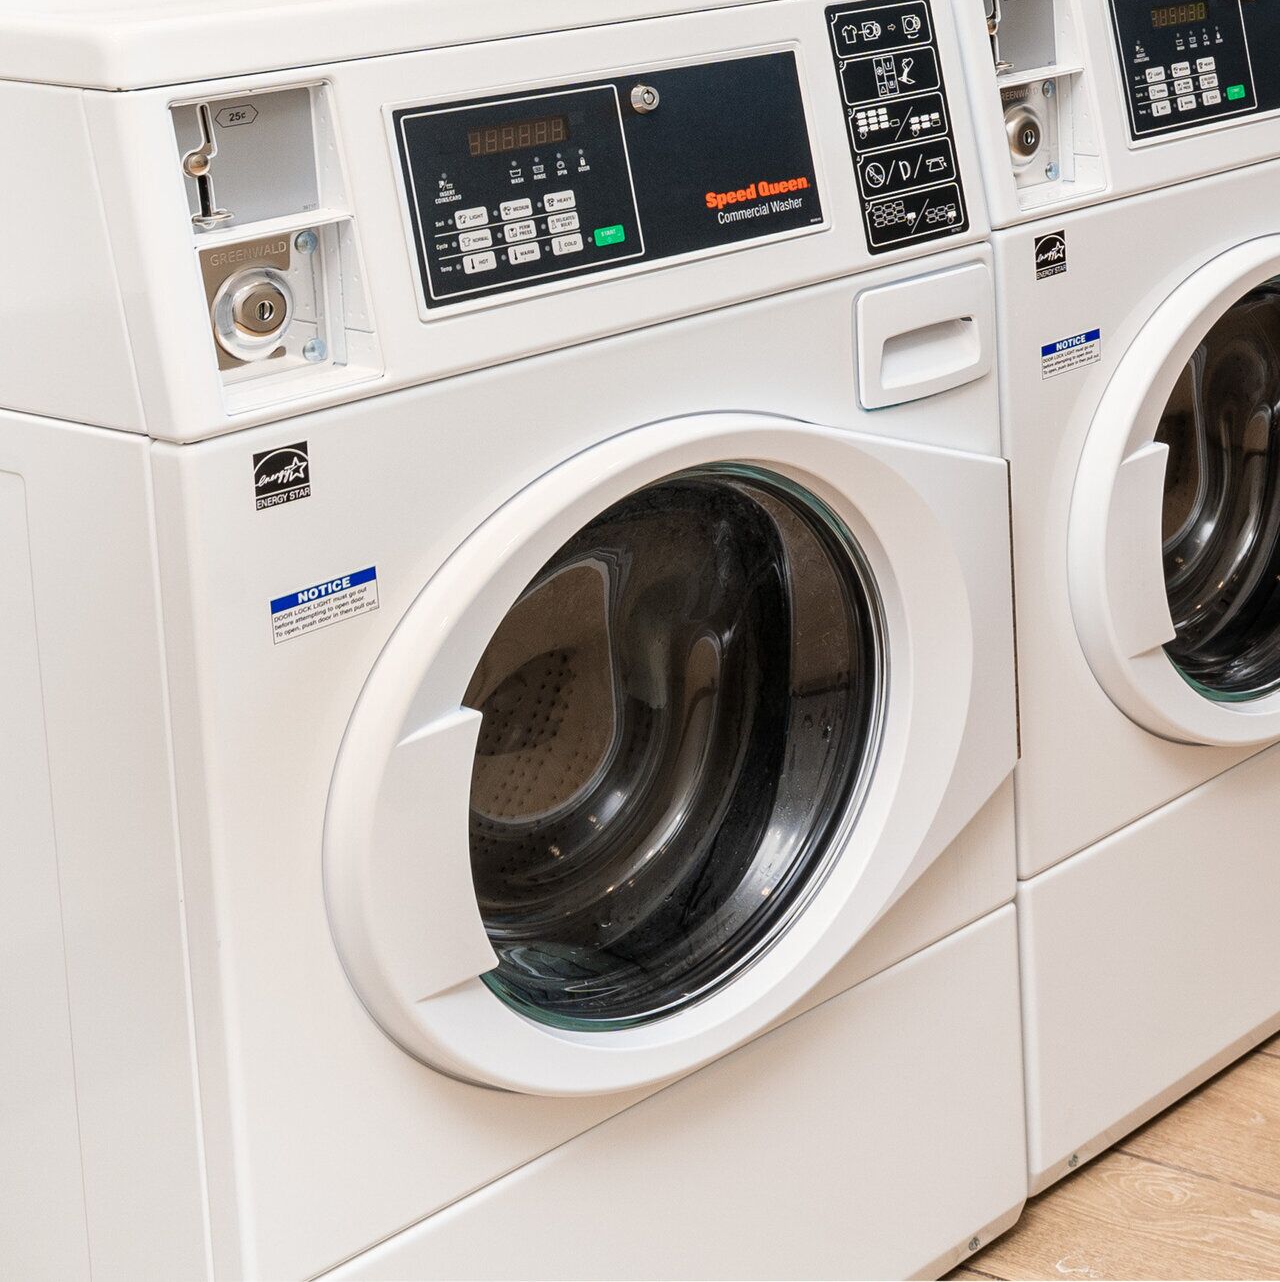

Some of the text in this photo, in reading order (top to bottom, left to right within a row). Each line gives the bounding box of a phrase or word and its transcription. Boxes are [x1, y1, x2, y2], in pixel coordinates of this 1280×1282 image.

[556, 196, 572, 204] HEAVY
[705, 176, 809, 210] Speed Queen
[468, 212, 484, 221] LIGHT
[717, 197, 803, 225] Commercial Washer
[209, 241, 288, 267] GREENWALD
[563, 240, 578, 248] COLD
[478, 258, 489, 266] HOT
[1056, 334, 1086, 351] NOTICE
[256, 487, 311, 509] ENERGY STAR
[297, 576, 351, 604] NOTICE
[274, 586, 367, 623] DOOR LOCK LIGHT must go out
[274, 620, 294, 630] before
[295, 608, 327, 624] attempting
[334, 600, 350, 610] open
[301, 619, 317, 630] push
[318, 614, 332, 624] door
[339, 606, 353, 616] then
[353, 603, 365, 612] pull
